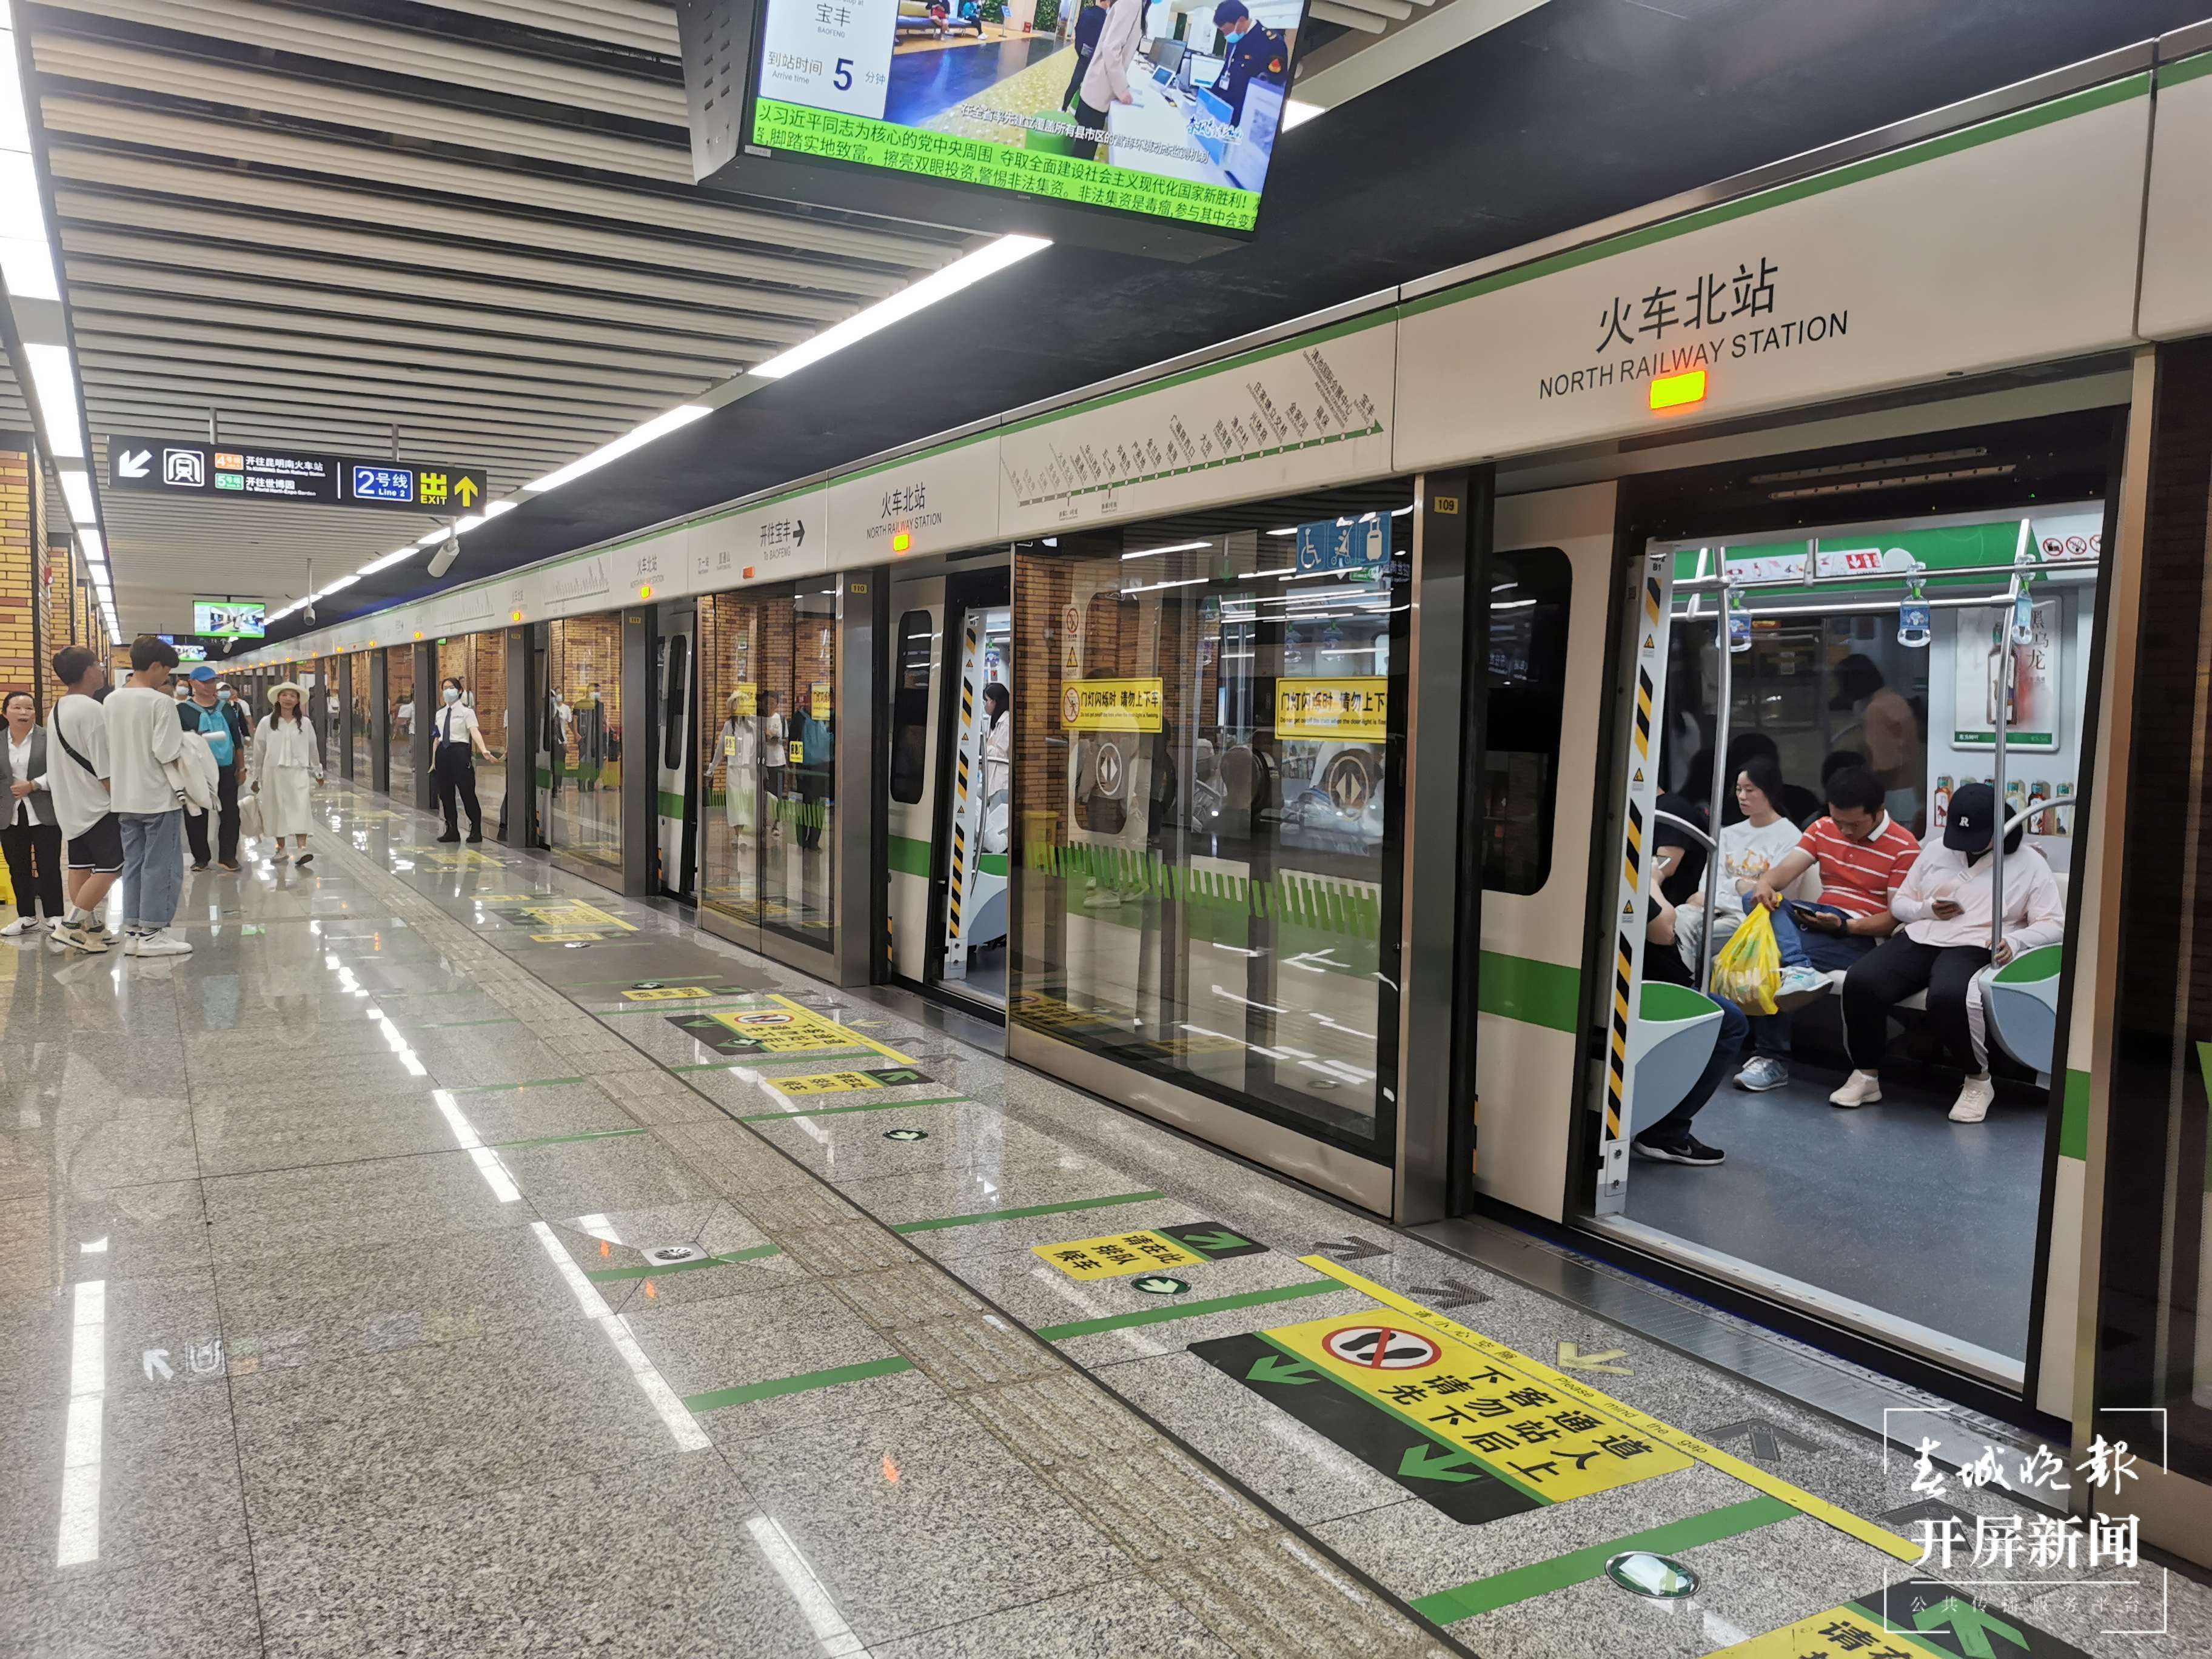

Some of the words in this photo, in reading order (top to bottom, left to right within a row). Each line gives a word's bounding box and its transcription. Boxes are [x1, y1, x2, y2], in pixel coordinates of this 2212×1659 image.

[815, 3, 851, 27] 宝丰
[817, 27, 845, 38] BAOFENG
[767, 51, 822, 76] 到站时间
[833, 58, 854, 91] 5
[772, 70, 793, 82] Arrive
[794, 73, 809, 84] time
[865, 70, 885, 85] 分钟
[1596, 257, 1778, 354] 火车北站
[1540, 363, 1613, 400] NORTH
[1620, 338, 1725, 383] RAILWAY
[1731, 310, 1848, 358] STATION
[246, 456, 323, 471] 开往昆明南火车站
[246, 477, 295, 490] 开往世博园
[357, 471, 407, 495] 2号线
[420, 495, 447, 505] EXIT
[882, 481, 925, 520] 火车北站
[1438, 500, 1455, 511] 109
[760, 520, 791, 547] 开往宝丰
[867, 526, 887, 540] NORTH
[888, 518, 913, 535] RAILWAY
[914, 513, 942, 529] STATION
[763, 551, 769, 561] To
[769, 546, 791, 560] BAOFENG
[1081, 691, 1116, 708] 门灯闪烁时
[1120, 690, 1159, 708] 请勿上下车
[1281, 691, 1333, 711] 门灯闪烁时
[1340, 691, 1389, 712] 请勿上下
[1960, 816, 1969, 828] R
[1053, 1250, 1103, 1272] 候车
[1091, 1244, 1141, 1267] 排队
[1122, 1235, 1185, 1265] 请在此
[1414, 1309, 1520, 1362] 请小心空隙
[1421, 1374, 1603, 1470] 请勿站人
[1469, 1364, 1655, 1461] 下客通道
[1554, 1376, 1595, 1400] Please
[1604, 1401, 1640, 1419] mind
[1647, 1421, 1670, 1436] the
[1677, 1439, 1709, 1455] gap
[1378, 1384, 1561, 1484] 先下后上
